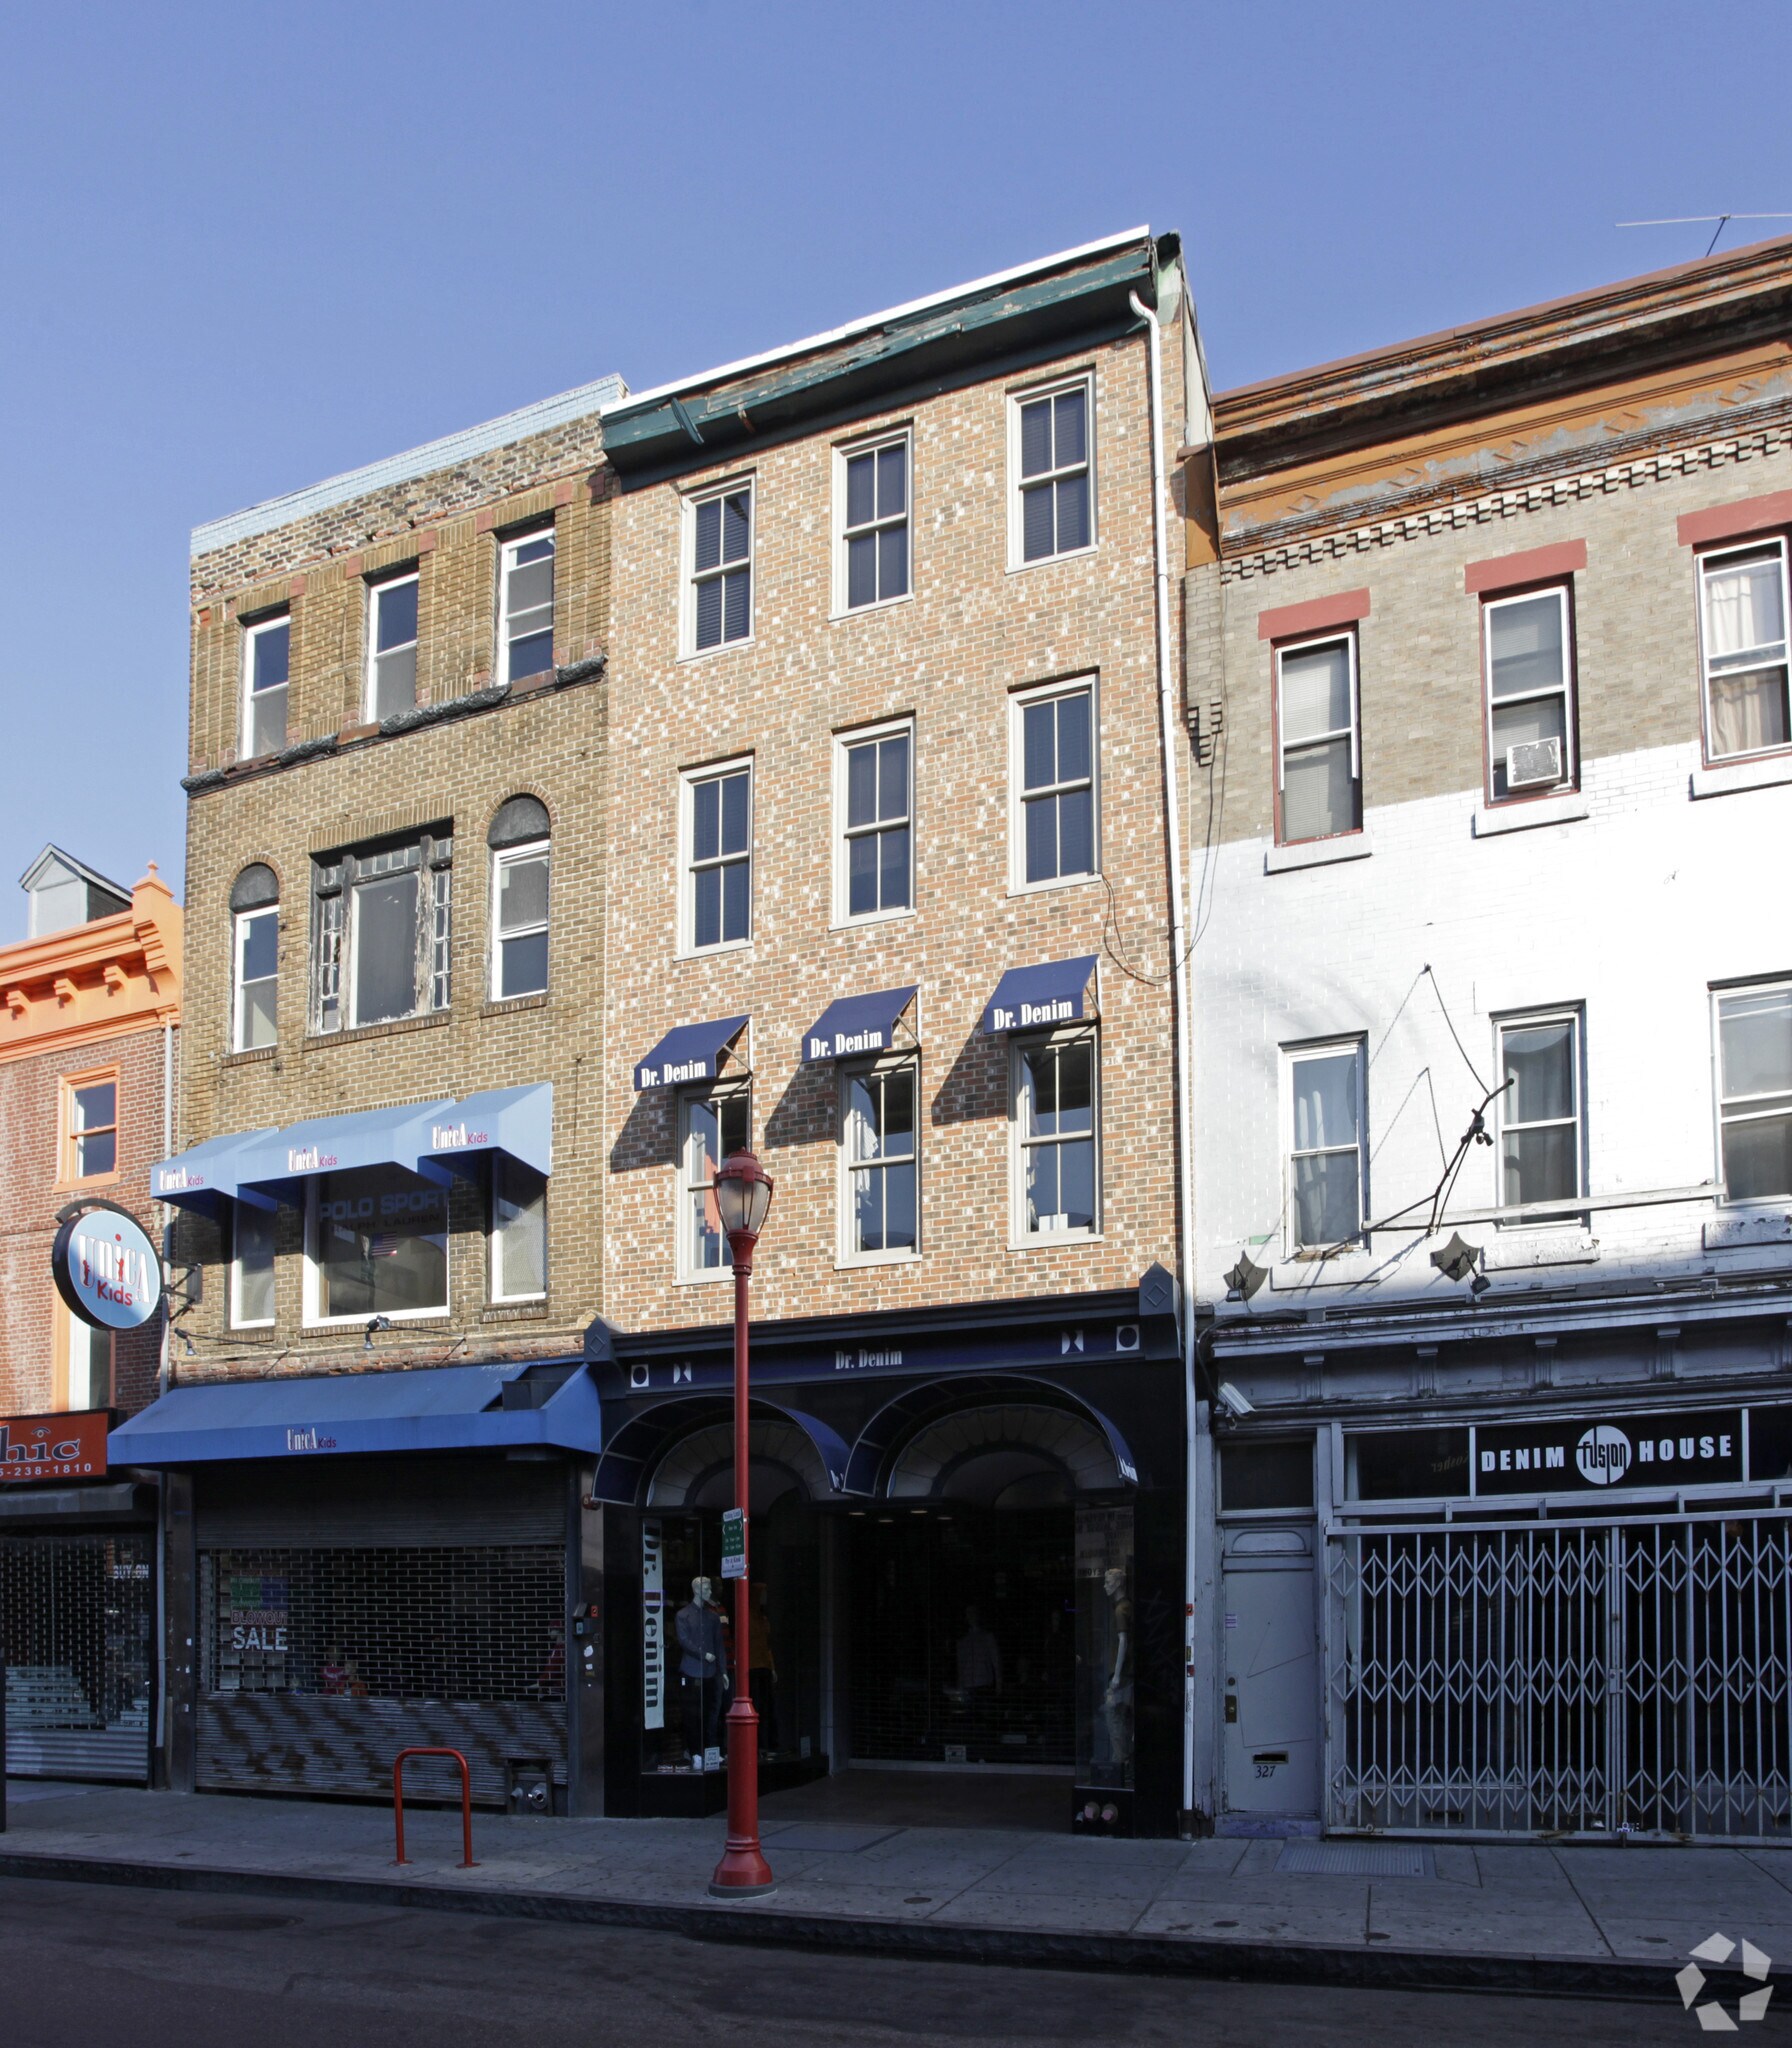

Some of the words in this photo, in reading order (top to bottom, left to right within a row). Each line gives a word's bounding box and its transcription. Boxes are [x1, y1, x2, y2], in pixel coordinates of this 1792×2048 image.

[993, 1008, 1016, 1030] Dr.
[1020, 998, 1073, 1026] Denim
[810, 1037, 831, 1058] Dr.
[835, 1029, 883, 1055] Denim
[640, 1067, 660, 1088] Dr.
[663, 1059, 706, 1084] Denim
[467, 1131, 488, 1144] Kids
[319, 1154, 338, 1167] Kids
[187, 1174, 204, 1187] Kids
[319, 1196, 374, 1221] POLO
[384, 1212, 440, 1227] LAUREN
[96, 1280, 133, 1306] Kids
[835, 1350, 855, 1369] Dr.
[858, 1347, 903, 1368] Denim
[317, 1437, 337, 1449] Kids
[1481, 1446, 1565, 1472] DENIM
[1638, 1434, 1732, 1463] HOUSE
[231, 1610, 288, 1625] BLOWOUT
[232, 1626, 289, 1651] SALE
[645, 1591, 662, 1708] Denim
[1255, 1765, 1276, 1779] 327
